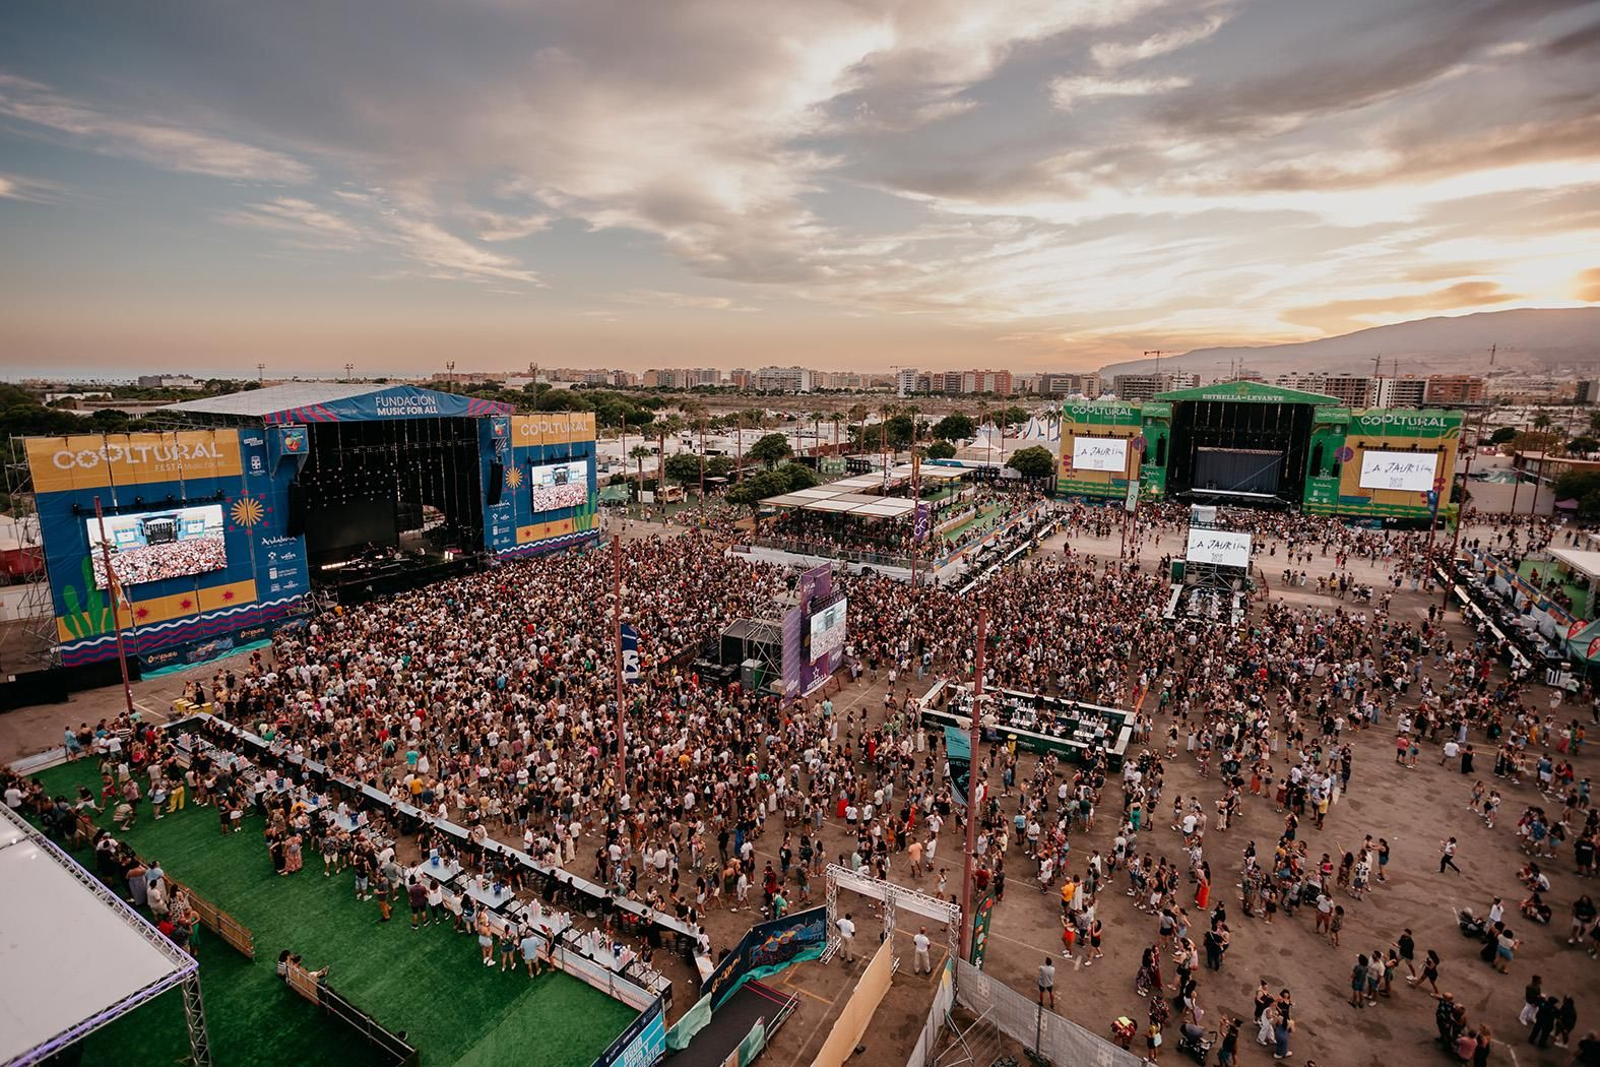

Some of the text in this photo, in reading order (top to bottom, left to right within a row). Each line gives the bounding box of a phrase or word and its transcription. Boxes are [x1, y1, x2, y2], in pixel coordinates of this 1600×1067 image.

[375, 394, 436, 407] FUNDACIÓN
[377, 405, 438, 416] MUSIC FOR ALL
[1071, 405, 1133, 416] COOLTURAL
[1360, 413, 1447, 427] COOLTURAL
[520, 420, 589, 436] COOLTURAL
[52, 441, 224, 470] COOLTURAL
